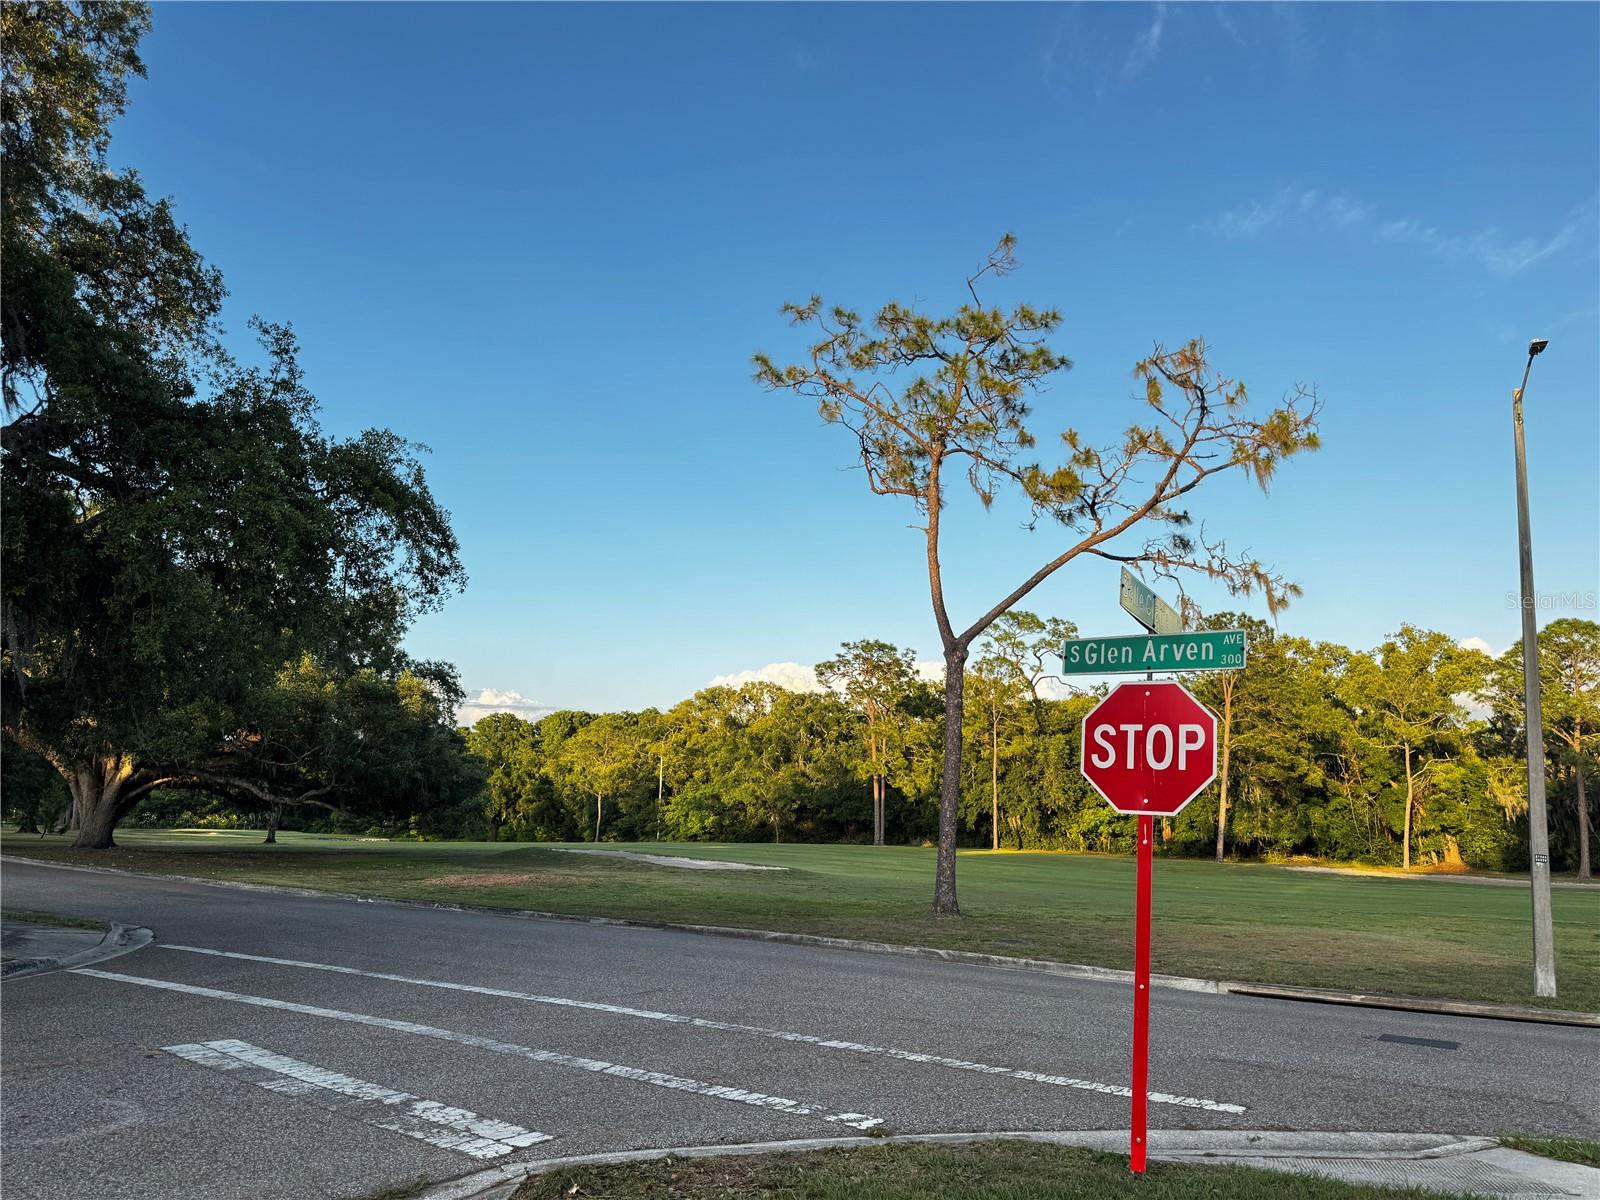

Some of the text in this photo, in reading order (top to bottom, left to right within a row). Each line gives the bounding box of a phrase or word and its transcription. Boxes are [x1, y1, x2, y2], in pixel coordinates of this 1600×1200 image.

[1223, 633, 1243, 645] AVE
[1070, 639, 1214, 665] S Glen Arven
[1220, 653, 1242, 665] 300
[1091, 723, 1206, 771] STOP
